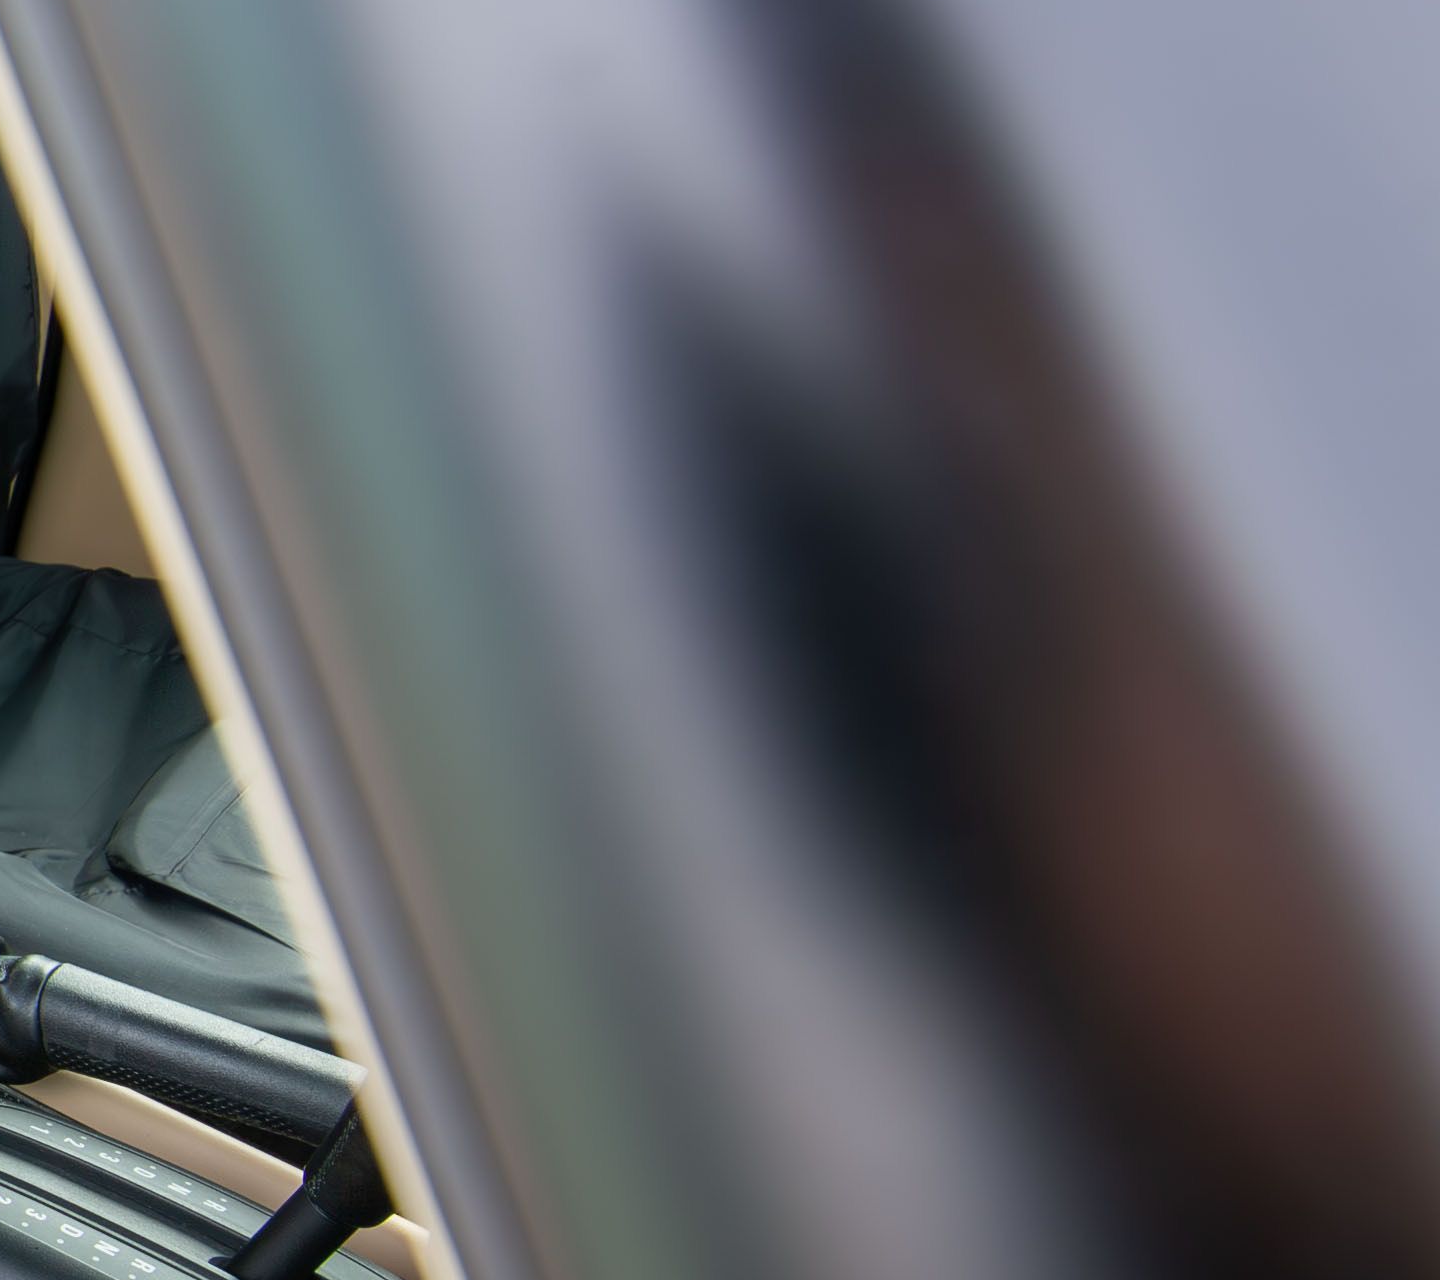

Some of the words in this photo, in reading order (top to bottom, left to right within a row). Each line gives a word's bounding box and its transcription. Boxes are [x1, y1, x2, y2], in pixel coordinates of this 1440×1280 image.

[30, 1125, 50, 1134] 1
[64, 1137, 85, 1148] 2
[98, 1152, 120, 1163] 3
[133, 1166, 156, 1179] D
[168, 1182, 192, 1196] N
[203, 1199, 227, 1212] R
[25, 1208, 47, 1220] 3
[60, 1223, 84, 1238] D
[94, 1240, 120, 1256] N
[131, 1258, 156, 1274] R
